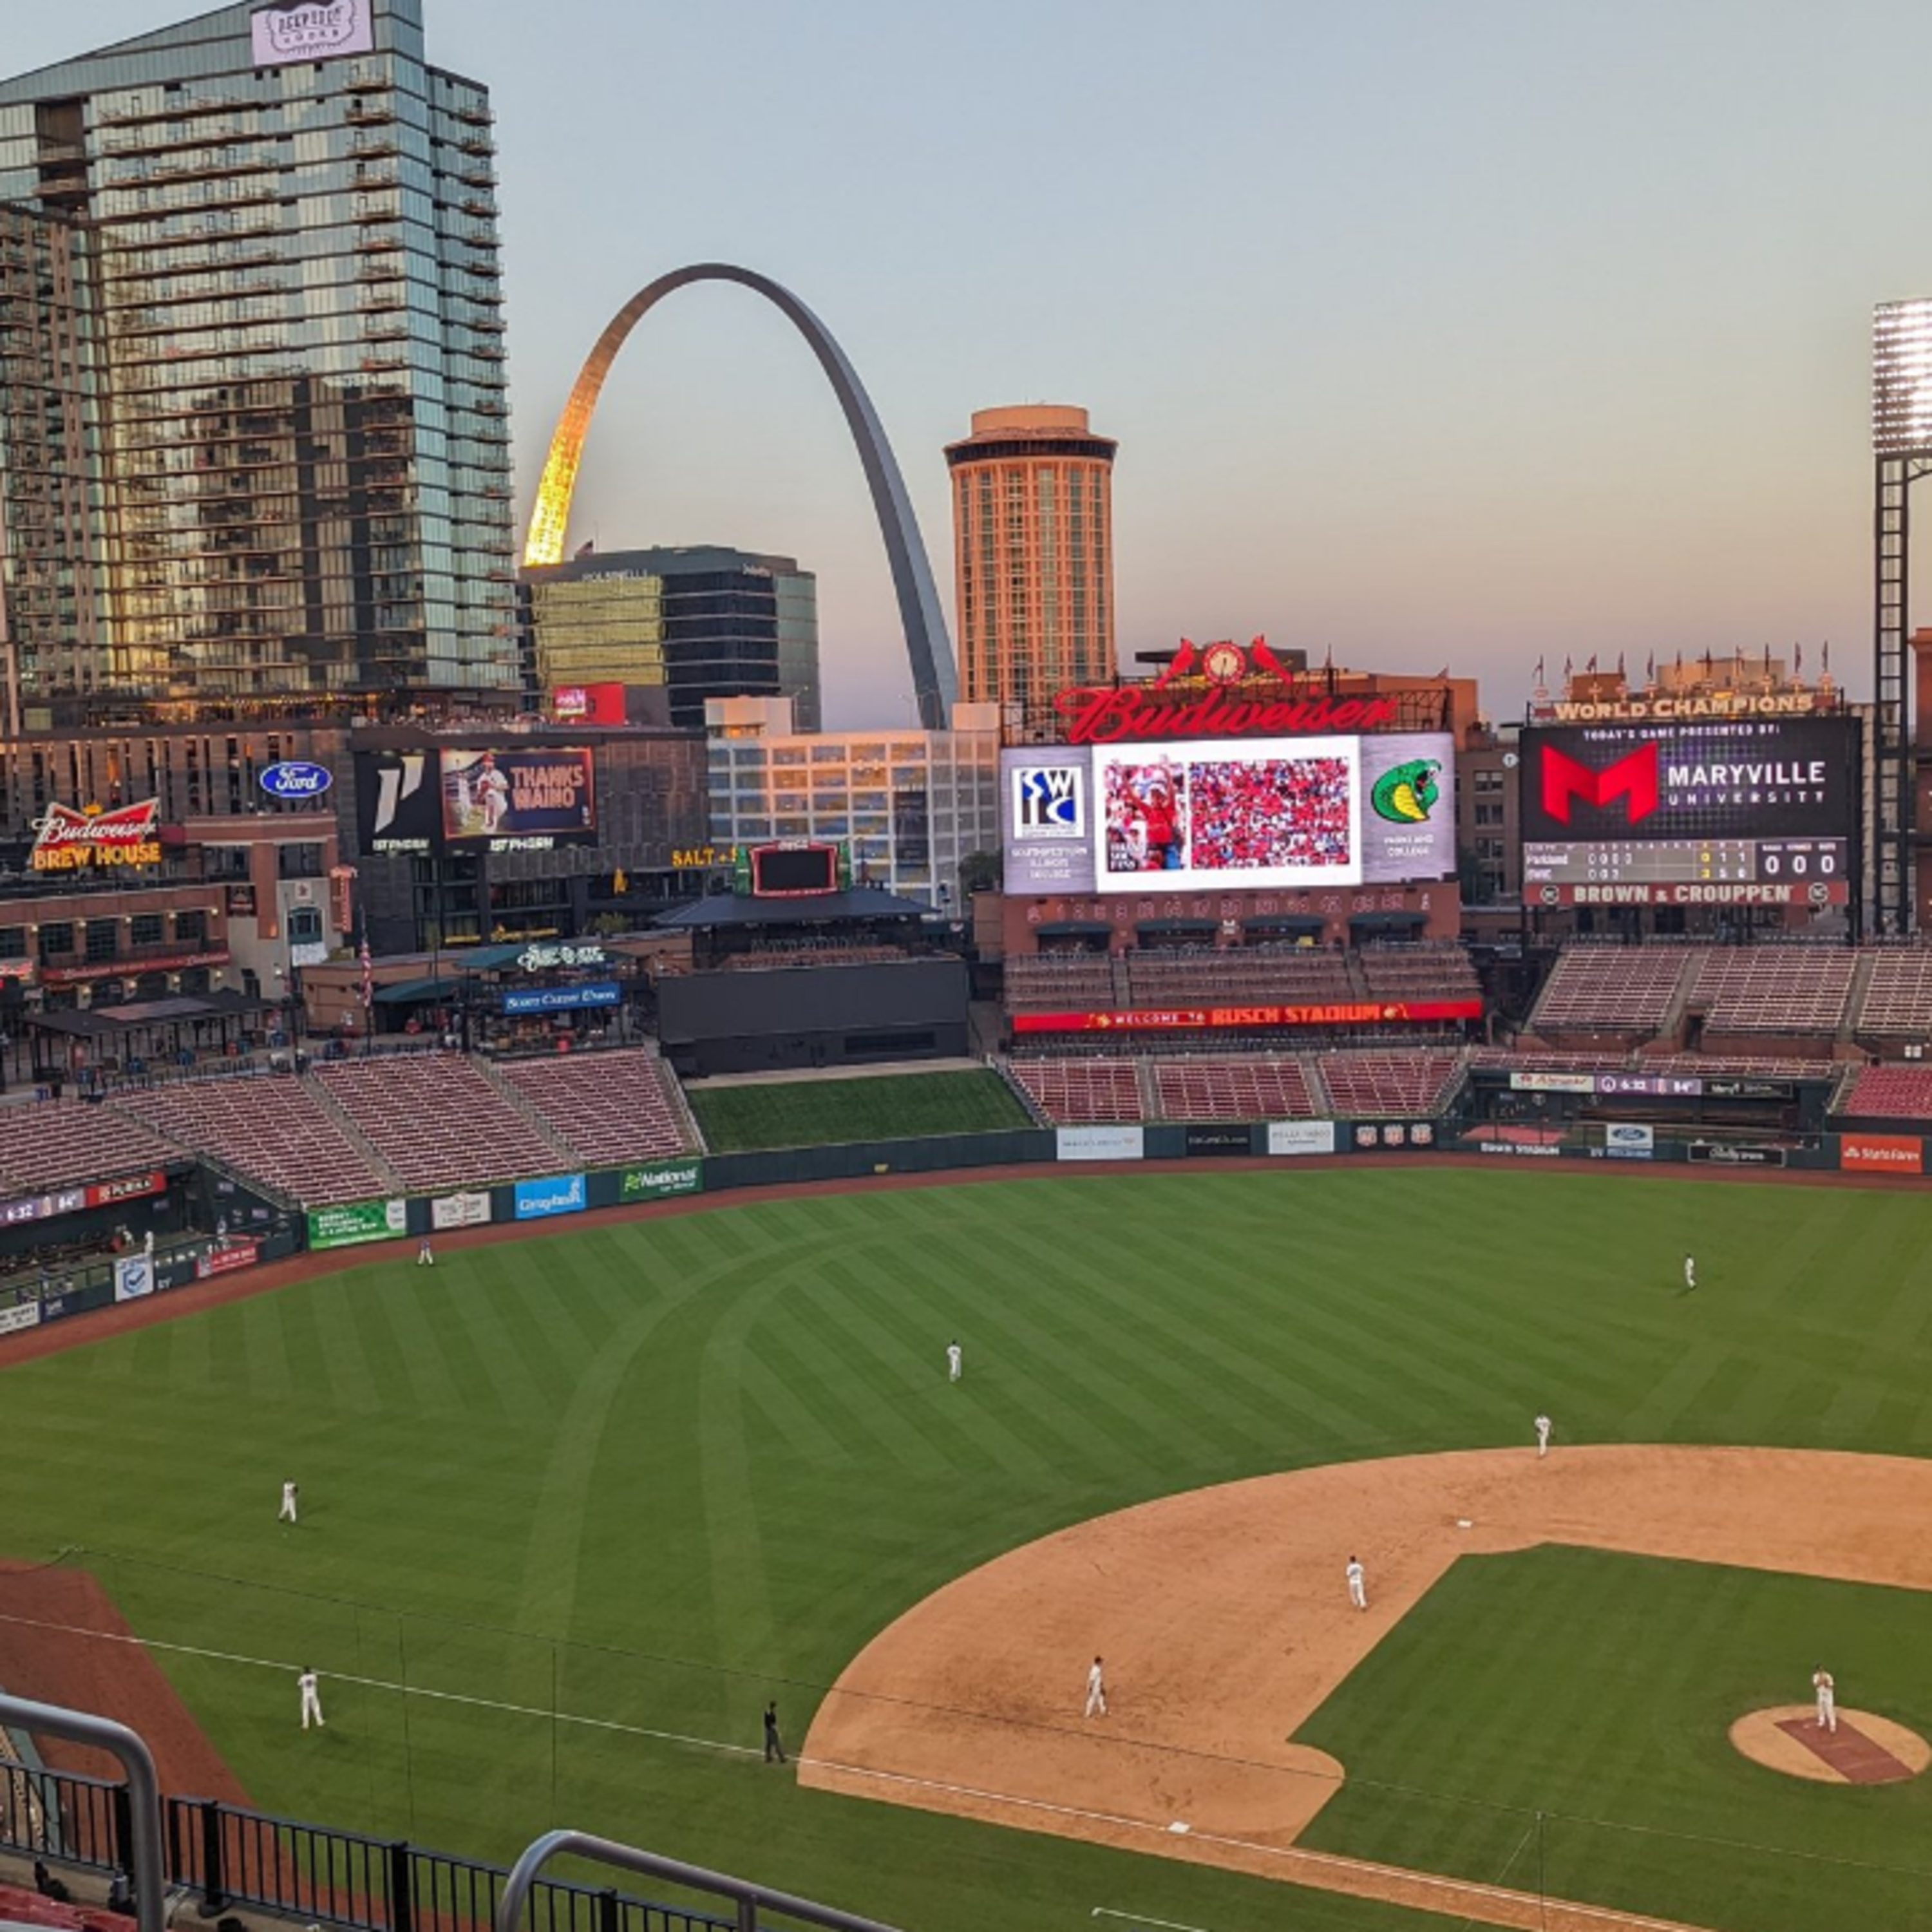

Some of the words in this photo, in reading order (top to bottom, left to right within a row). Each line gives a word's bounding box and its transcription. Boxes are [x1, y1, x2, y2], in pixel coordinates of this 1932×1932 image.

[1054, 685, 1398, 744] Budweiser
[1554, 701, 1647, 721] WORLD
[1653, 693, 1814, 716] CHAMPIONS
[1583, 728, 1636, 740] TODAY'S
[1640, 728, 1674, 739] GAME
[1678, 724, 1753, 737] PRESENTED
[275, 766, 318, 790] Ford
[510, 765, 584, 788] THANKS
[1668, 761, 1826, 787] MARYVILLE
[511, 788, 576, 811] WAINO
[1668, 791, 1824, 805] UNIVERSITY
[32, 817, 157, 844] Budweiser
[34, 846, 91, 870] BREW
[97, 842, 161, 865] HOUSE
[672, 848, 715, 866] SALT
[1765, 855, 1779, 874] 0
[1792, 855, 1806, 873] 0
[1821, 855, 1835, 873] 0
[1573, 884, 1649, 903] BROWN
[1675, 884, 1791, 902] CROUPPEN
[1115, 1013, 1181, 1025] WELCOME
[1211, 1007, 1280, 1025] BUSCH
[1285, 1005, 1380, 1023] STADIUM
[641, 1167, 697, 1187] National
